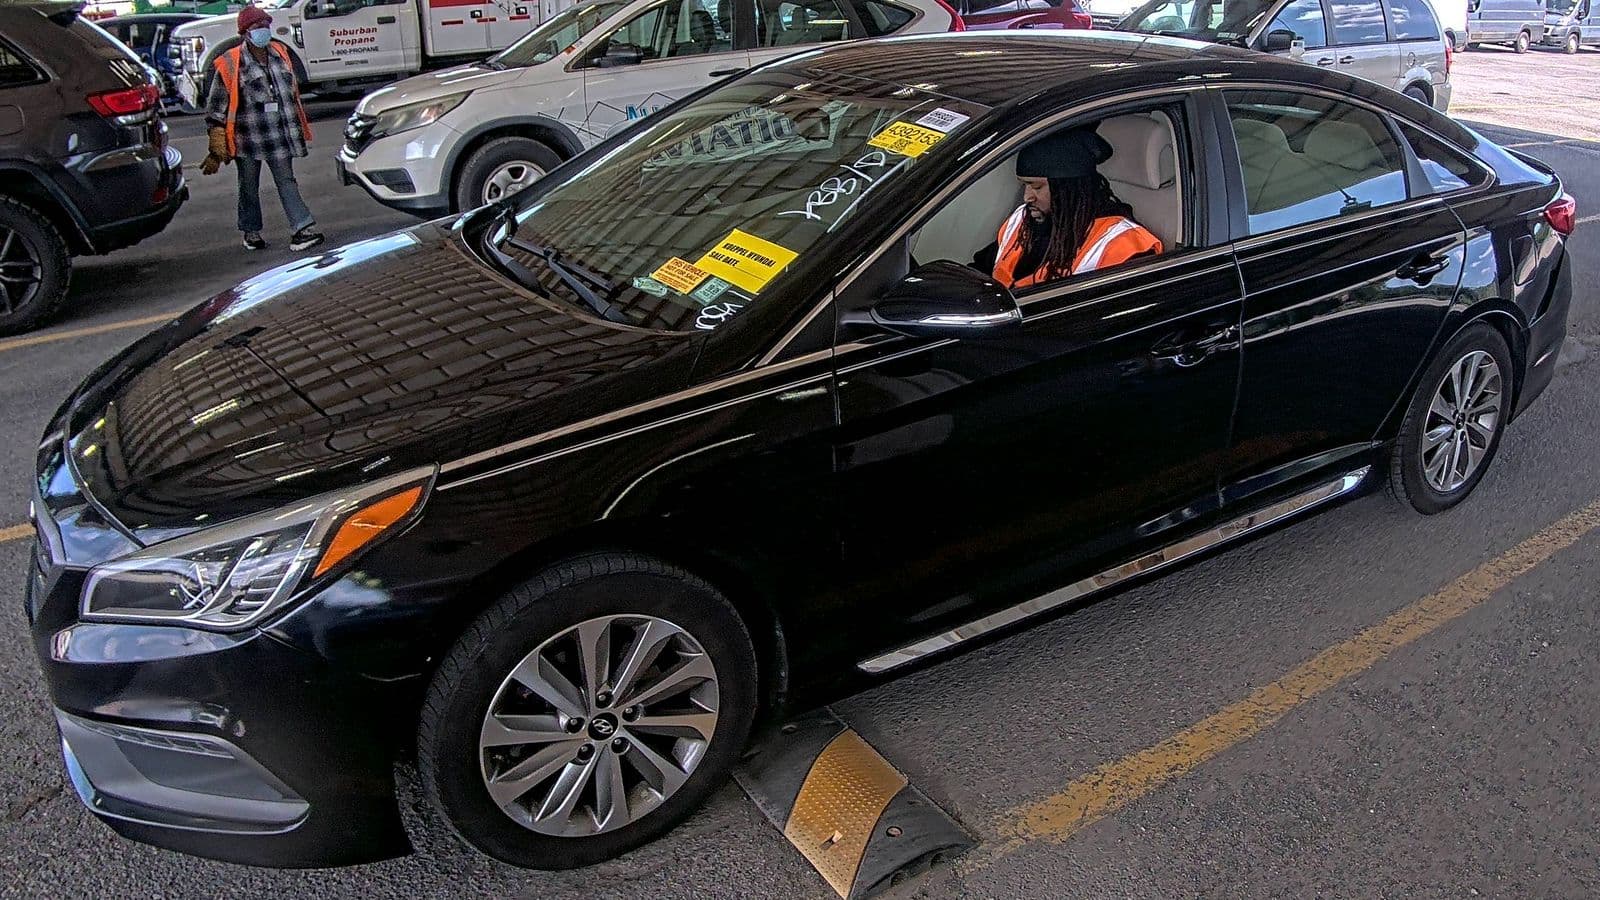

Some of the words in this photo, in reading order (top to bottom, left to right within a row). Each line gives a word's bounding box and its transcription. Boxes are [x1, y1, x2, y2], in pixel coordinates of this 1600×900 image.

[329, 26, 378, 37] Suburban
[334, 36, 376, 46] Propane
[331, 46, 379, 56] 1-800-PROPANE
[888, 125, 941, 146] 4392153
[708, 250, 723, 262] SALE
[721, 256, 741, 267] DATE
[746, 251, 777, 268] HYUNDAI
[682, 261, 707, 276] VEHICLE
[685, 271, 699, 282] SALE
